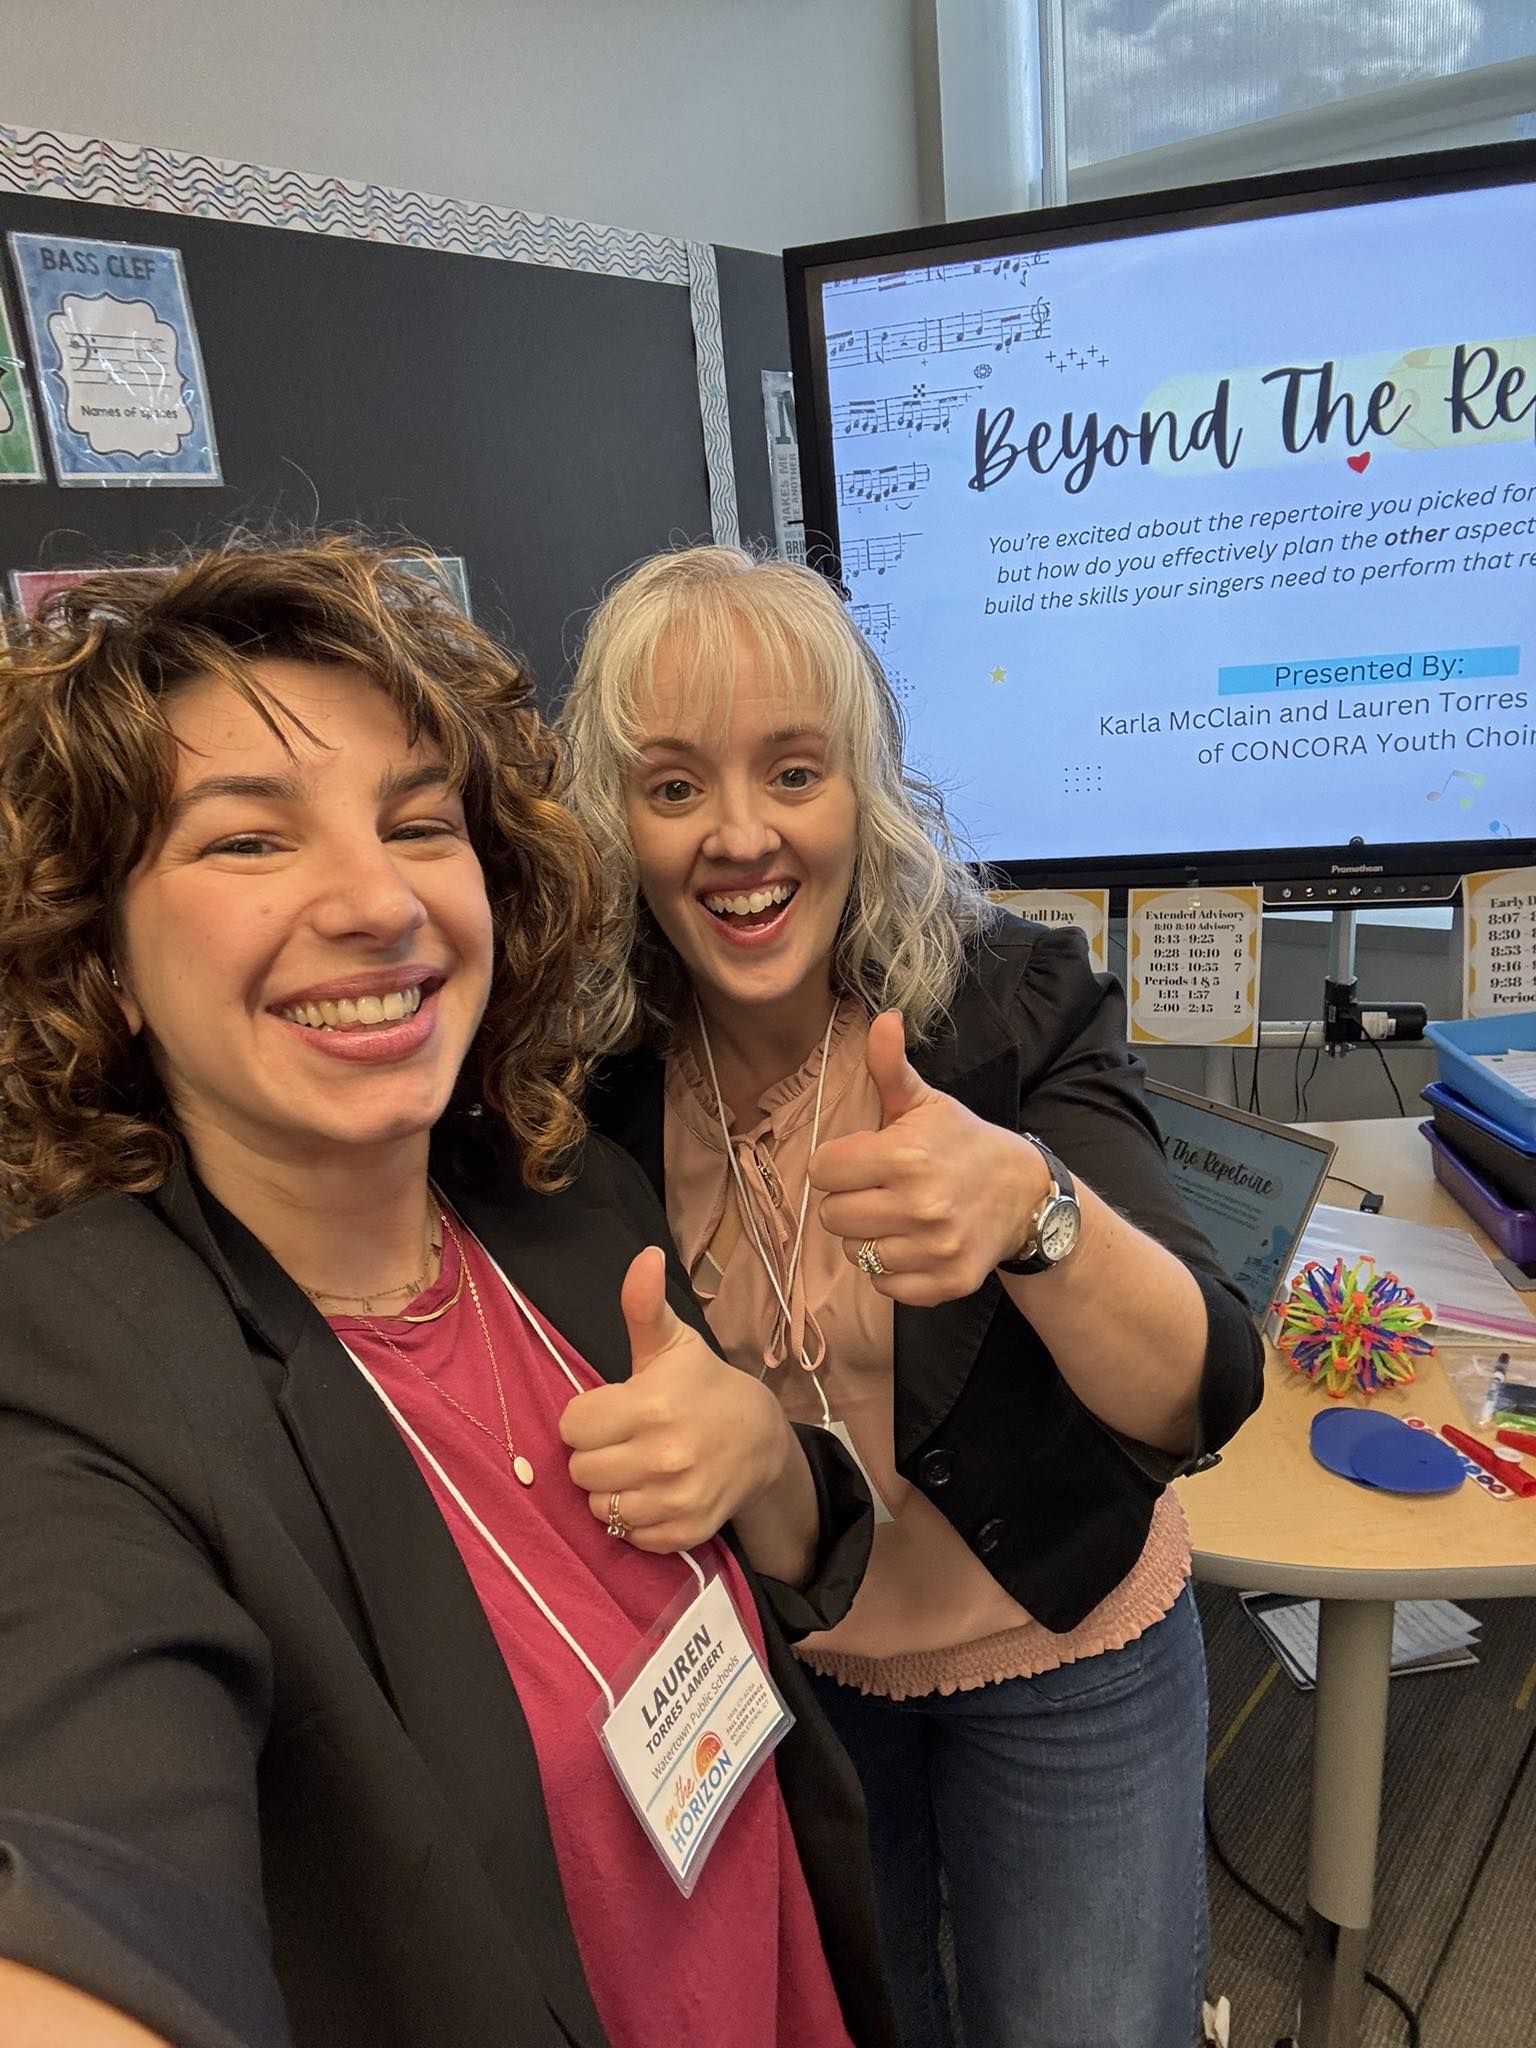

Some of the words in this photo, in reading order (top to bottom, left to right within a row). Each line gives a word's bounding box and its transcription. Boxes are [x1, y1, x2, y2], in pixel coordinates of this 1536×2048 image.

[40, 247, 99, 275] BASS
[106, 255, 155, 280] CLEF
[81, 404, 120, 418] Names
[124, 406, 137, 418] of
[968, 378, 1243, 494] Beyond
[1262, 361, 1412, 454] The
[1444, 344, 1536, 447] Re
[989, 532, 1050, 555] You're
[1055, 522, 1131, 547] excited
[1137, 517, 1202, 539] about
[1208, 512, 1244, 532] the
[1249, 500, 1363, 530] repertoire
[1367, 498, 1412, 521] you
[1417, 485, 1497, 516] picked
[1502, 483, 1536, 504] for
[997, 565, 1032, 584] but
[1037, 562, 1080, 581] how
[1085, 556, 1111, 575] do
[1115, 554, 1156, 577] you
[1162, 540, 1278, 568] effectively
[1282, 536, 1334, 561] plan
[1341, 531, 1378, 551] the
[1384, 525, 1450, 546] other
[1455, 517, 1536, 543] aspect
[984, 594, 1034, 615] build
[1040, 592, 1073, 610] the
[1078, 585, 1129, 606] skills
[1132, 582, 1183, 606] your
[1188, 574, 1264, 598] singers
[1271, 566, 1327, 589] need
[1333, 566, 1355, 583] to
[1361, 557, 1455, 586] perform
[1463, 551, 1514, 572] that
[1275, 655, 1412, 687] Presented
[1423, 655, 1464, 682] By:
[1100, 712, 1161, 736] Karla
[1170, 705, 1271, 731] McClain
[1280, 700, 1328, 723] and
[1338, 697, 1430, 720] Lauren
[1439, 691, 1528, 712] Torres
[1198, 742, 1225, 764] of
[1231, 735, 1368, 762] CONCORA
[1377, 728, 1456, 753] Youth
[1331, 864, 1384, 874] Promethean
[1491, 896, 1523, 909] Early
[1022, 910, 1047, 921] Full
[1051, 910, 1076, 924] Day
[1146, 910, 1196, 920] Extended
[1199, 909, 1245, 921] Advisory
[1488, 912, 1520, 925] 8:07
[1197, 922, 1235, 932] Advisory
[1488, 929, 1521, 941] 8:30
[1235, 934, 1243, 944] 3
[1154, 948, 1180, 958] 9:28
[1189, 948, 1220, 958] 10:10
[1234, 949, 1242, 958] 6
[1491, 945, 1521, 957] 8:53
[1150, 962, 1179, 972] 10:13
[1234, 963, 1241, 972] 7
[1145, 976, 1188, 985] Periods
[1153, 1003, 1179, 1012] 2:00
[1234, 1004, 1241, 1013] 2
[1173, 1139, 1199, 1164] The
[641, 1624, 712, 1729] LAUREN
[645, 1699, 683, 1755] TORRES
[681, 1641, 726, 1705] LAMBERT
[651, 1722, 692, 1780] Watertown
[690, 1693, 713, 1726] Public
[711, 1654, 740, 1695] Schools
[670, 1749, 733, 1853] HORIZON
[675, 1775, 696, 1808] the
